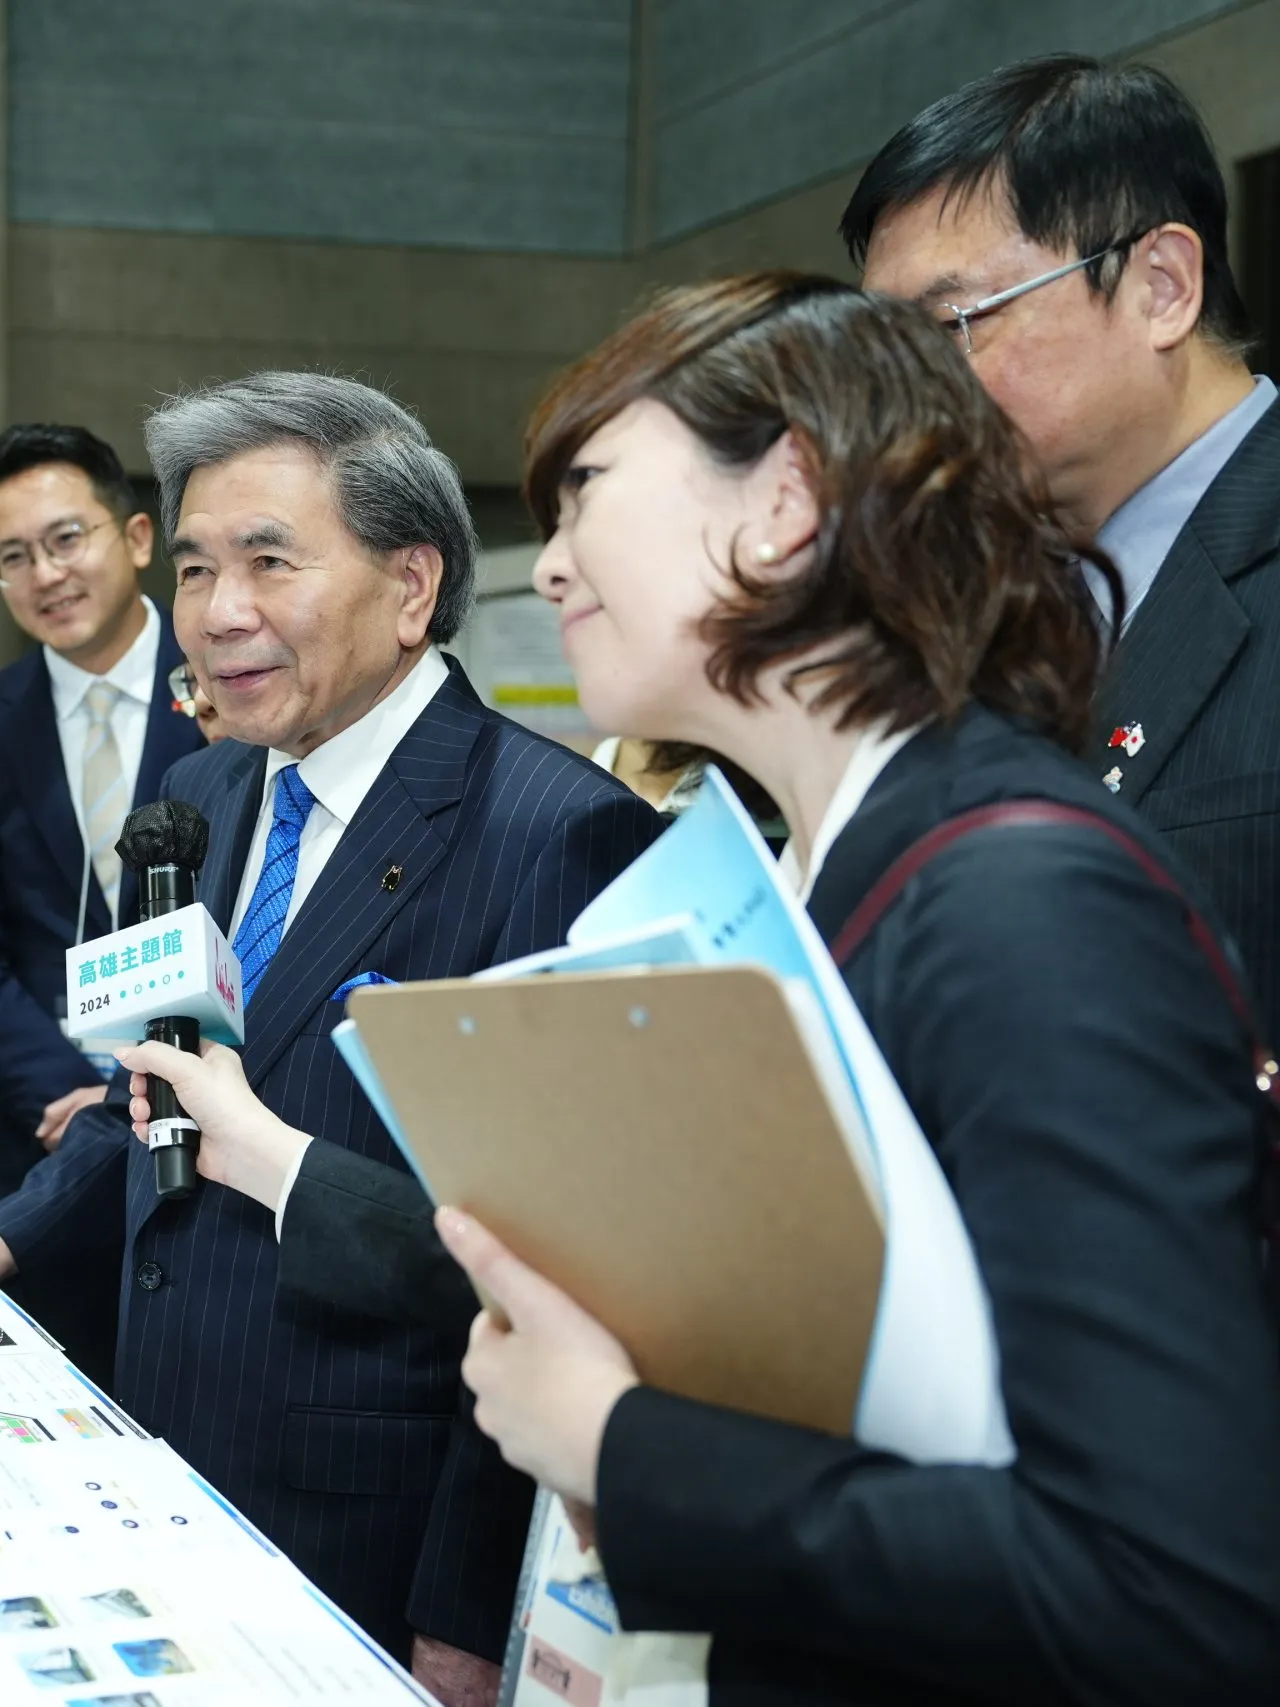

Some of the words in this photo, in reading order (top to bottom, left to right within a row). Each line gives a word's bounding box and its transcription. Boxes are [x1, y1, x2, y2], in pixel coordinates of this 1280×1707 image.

[148, 866, 176, 874] SHURE
[78, 928, 183, 988] 高雄主題館
[80, 994, 111, 1015] 2024
